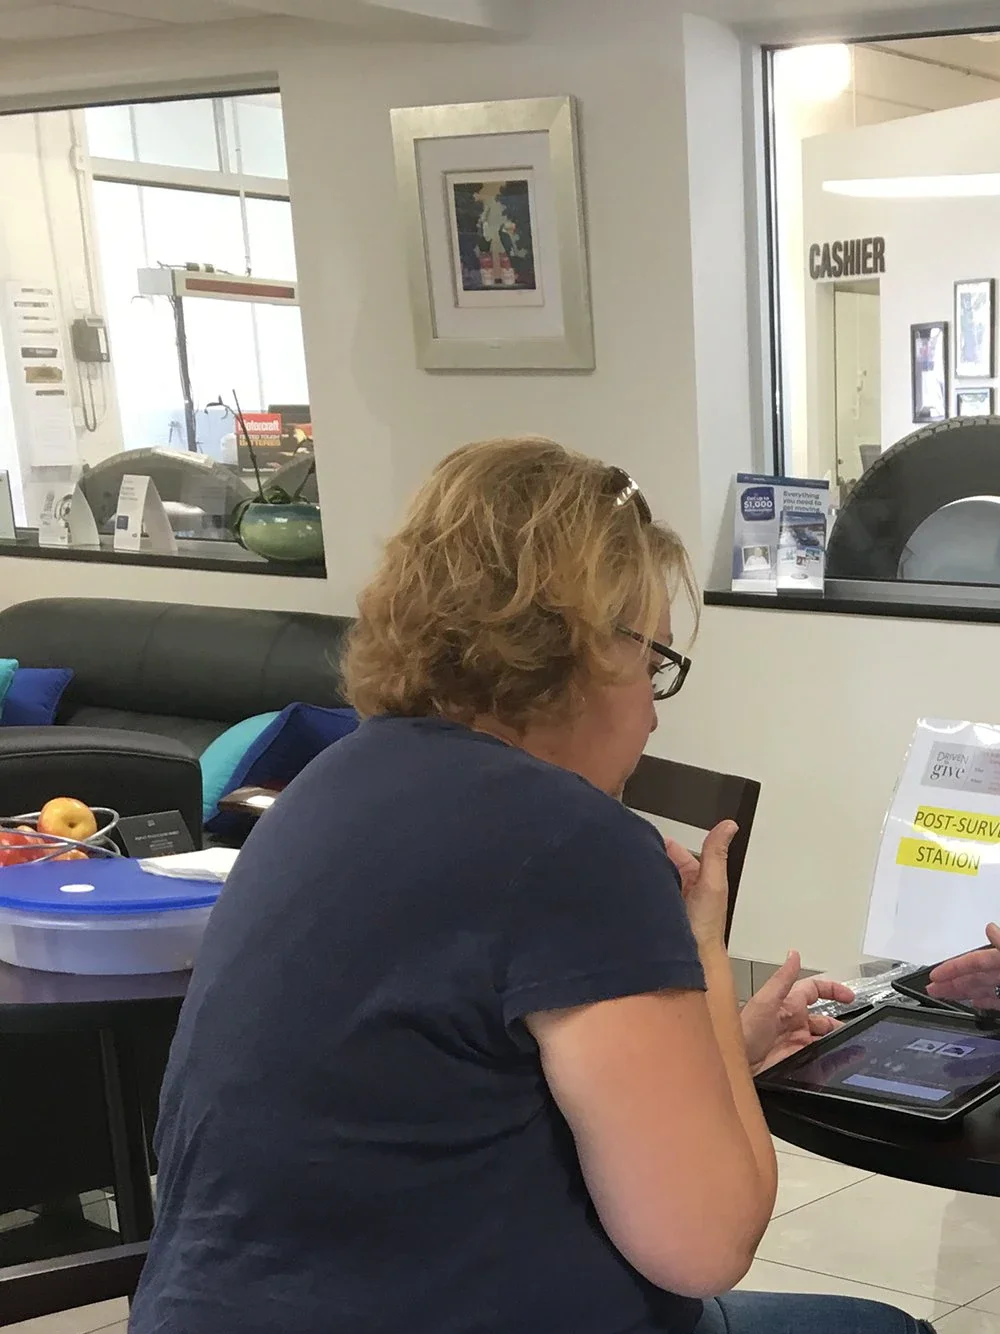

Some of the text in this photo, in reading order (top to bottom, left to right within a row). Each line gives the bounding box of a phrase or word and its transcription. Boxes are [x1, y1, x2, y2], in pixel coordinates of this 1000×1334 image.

[809, 236, 886, 280] CASHIER
[783, 491, 820, 499] Everything
[744, 501, 773, 509] $1,000
[936, 751, 970, 765] DRIVEN
[930, 763, 966, 780] give
[915, 846, 980, 870] STATION
